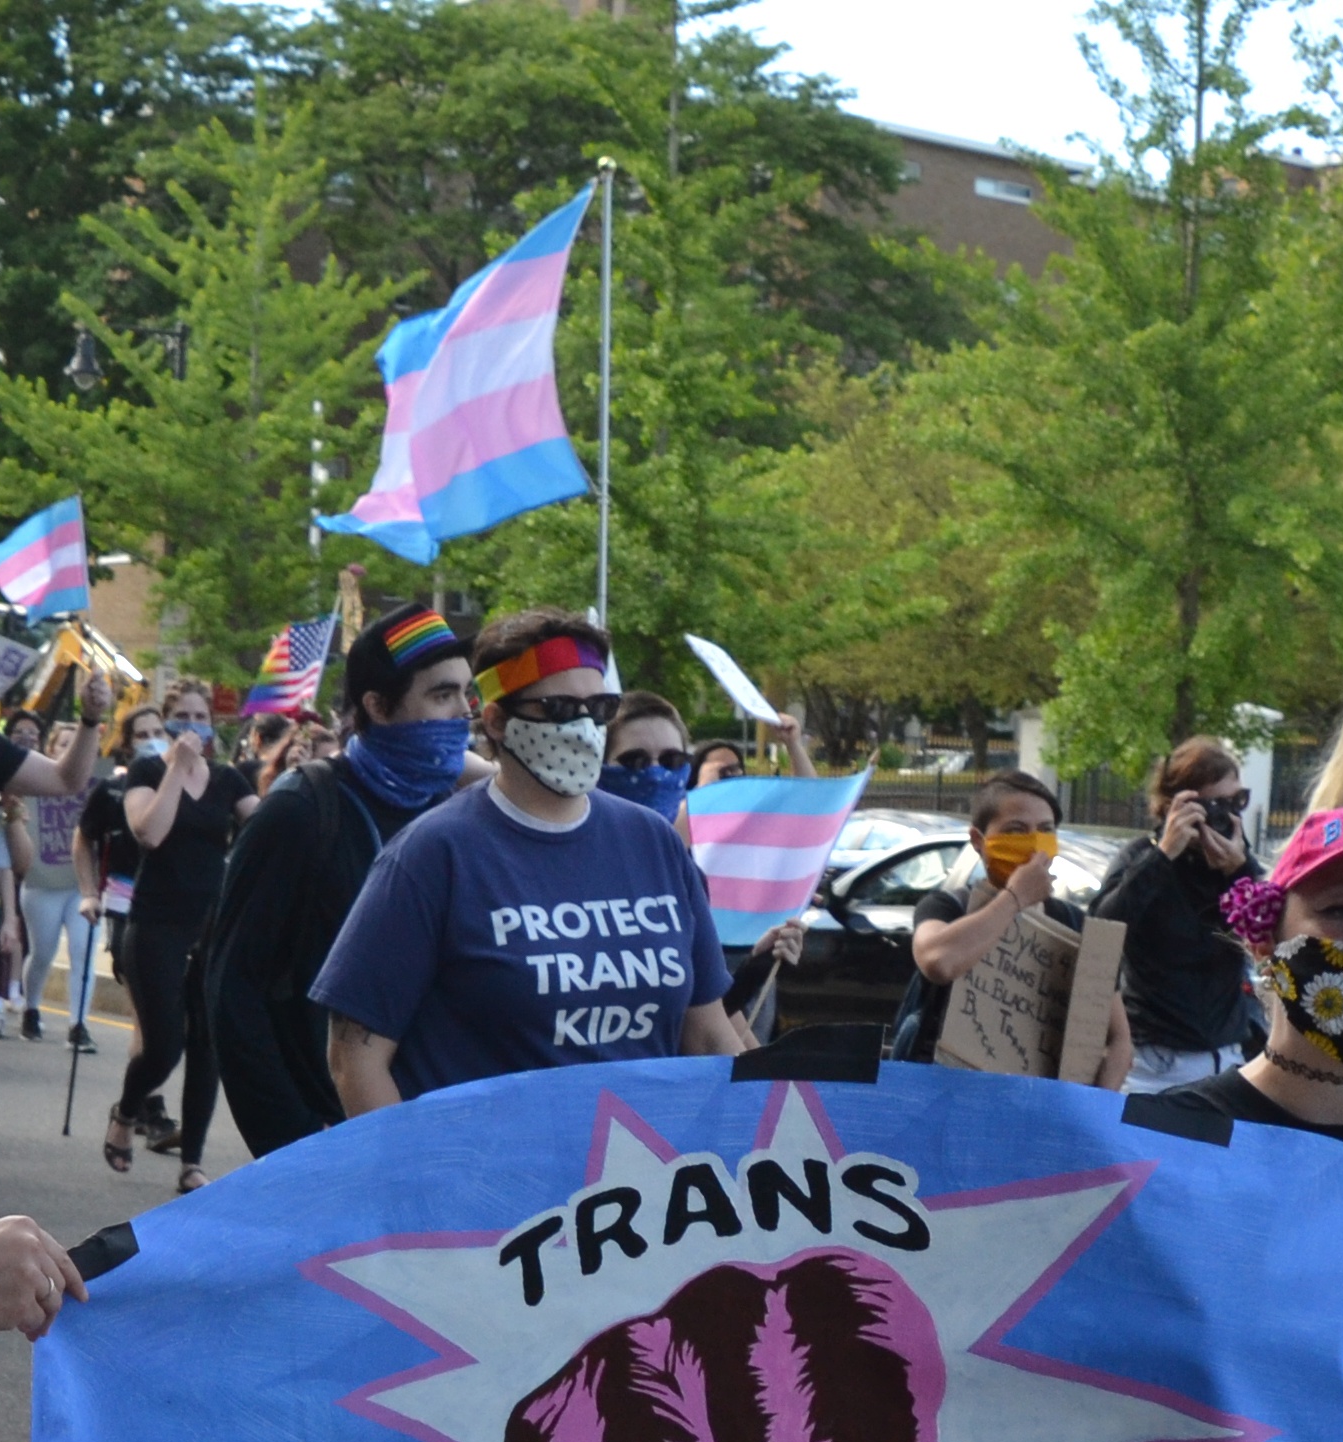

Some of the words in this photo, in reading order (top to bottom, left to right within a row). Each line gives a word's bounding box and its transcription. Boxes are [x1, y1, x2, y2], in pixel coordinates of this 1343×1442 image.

[490, 894, 683, 946] PROTECT
[525, 946, 686, 995] TRANS
[553, 1002, 660, 1046] KIDS
[500, 1158, 931, 1307] TRANS
